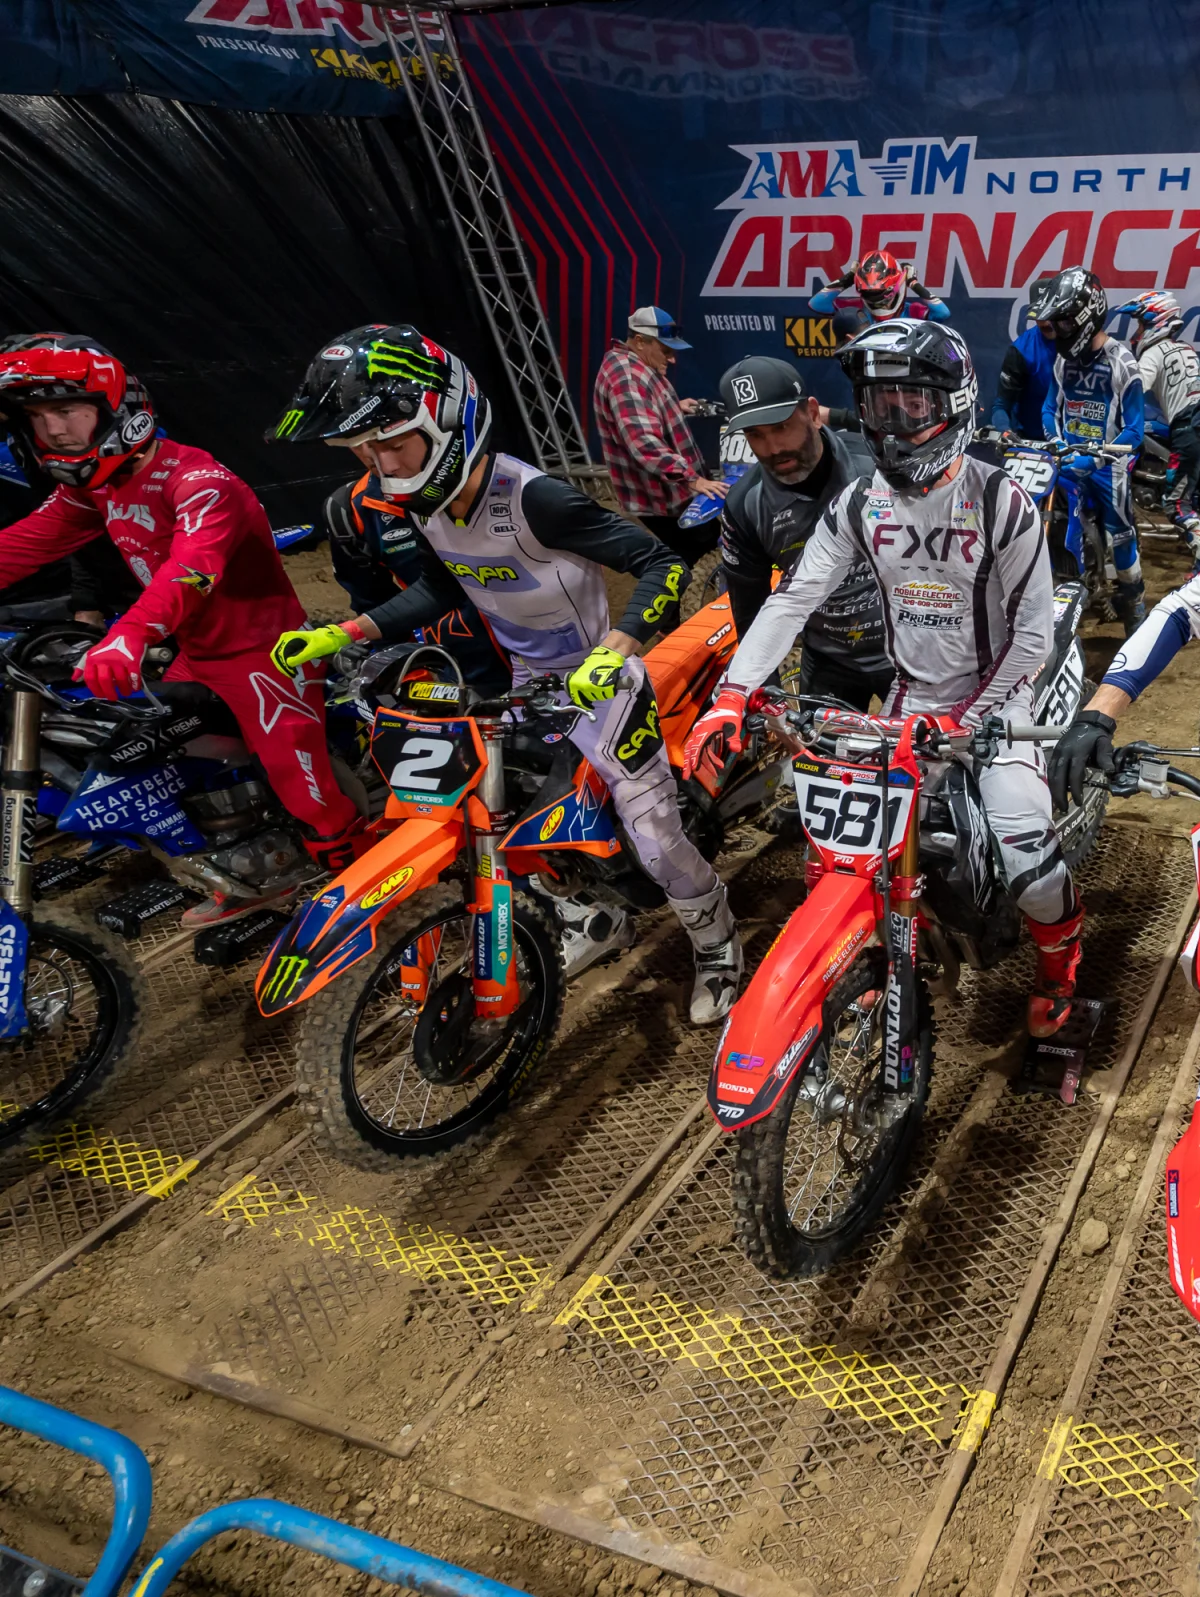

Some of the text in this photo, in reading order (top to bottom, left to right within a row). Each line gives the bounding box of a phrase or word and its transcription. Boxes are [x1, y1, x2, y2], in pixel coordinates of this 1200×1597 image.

[196, 35, 300, 59] PRESENTED BY
[742, 148, 866, 199] AMA
[869, 143, 970, 197] FIM
[986, 167, 1191, 196] NORTH
[704, 314, 777, 332] PRESENTED BY
[324, 348, 346, 358] BELL
[339, 395, 381, 432] apdesigns
[1083, 401, 1106, 411] GIZMO
[127, 414, 150, 442] Arai
[492, 506, 510, 516] 100%
[493, 524, 517, 534] BELL
[872, 523, 978, 564] FXR
[922, 588, 961, 600] ELECTRIC
[823, 621, 872, 633] POWERED
[411, 681, 461, 701] PROTAPER
[110, 740, 148, 763] NANO
[389, 736, 454, 792] 2
[76, 763, 180, 821] HEARTBEAT
[412, 794, 444, 804] MOTOREX
[87, 777, 187, 832] HOT SAUCE
[140, 808, 162, 823] CO.
[803, 783, 903, 850] 581
[542, 808, 563, 838] FMF
[833, 853, 856, 865] PTD
[366, 869, 413, 907] FMF
[137, 891, 185, 921] HEARTBEAT
[235, 915, 275, 944] HEARTBEAT
[499, 902, 509, 950] MOTOREX
[478, 917, 486, 968] DUNLOP
[885, 975, 902, 1090] DUNLOP
[725, 1051, 765, 1071] FCP
[717, 1081, 755, 1095] HONDA
[717, 1104, 746, 1119] PTD
